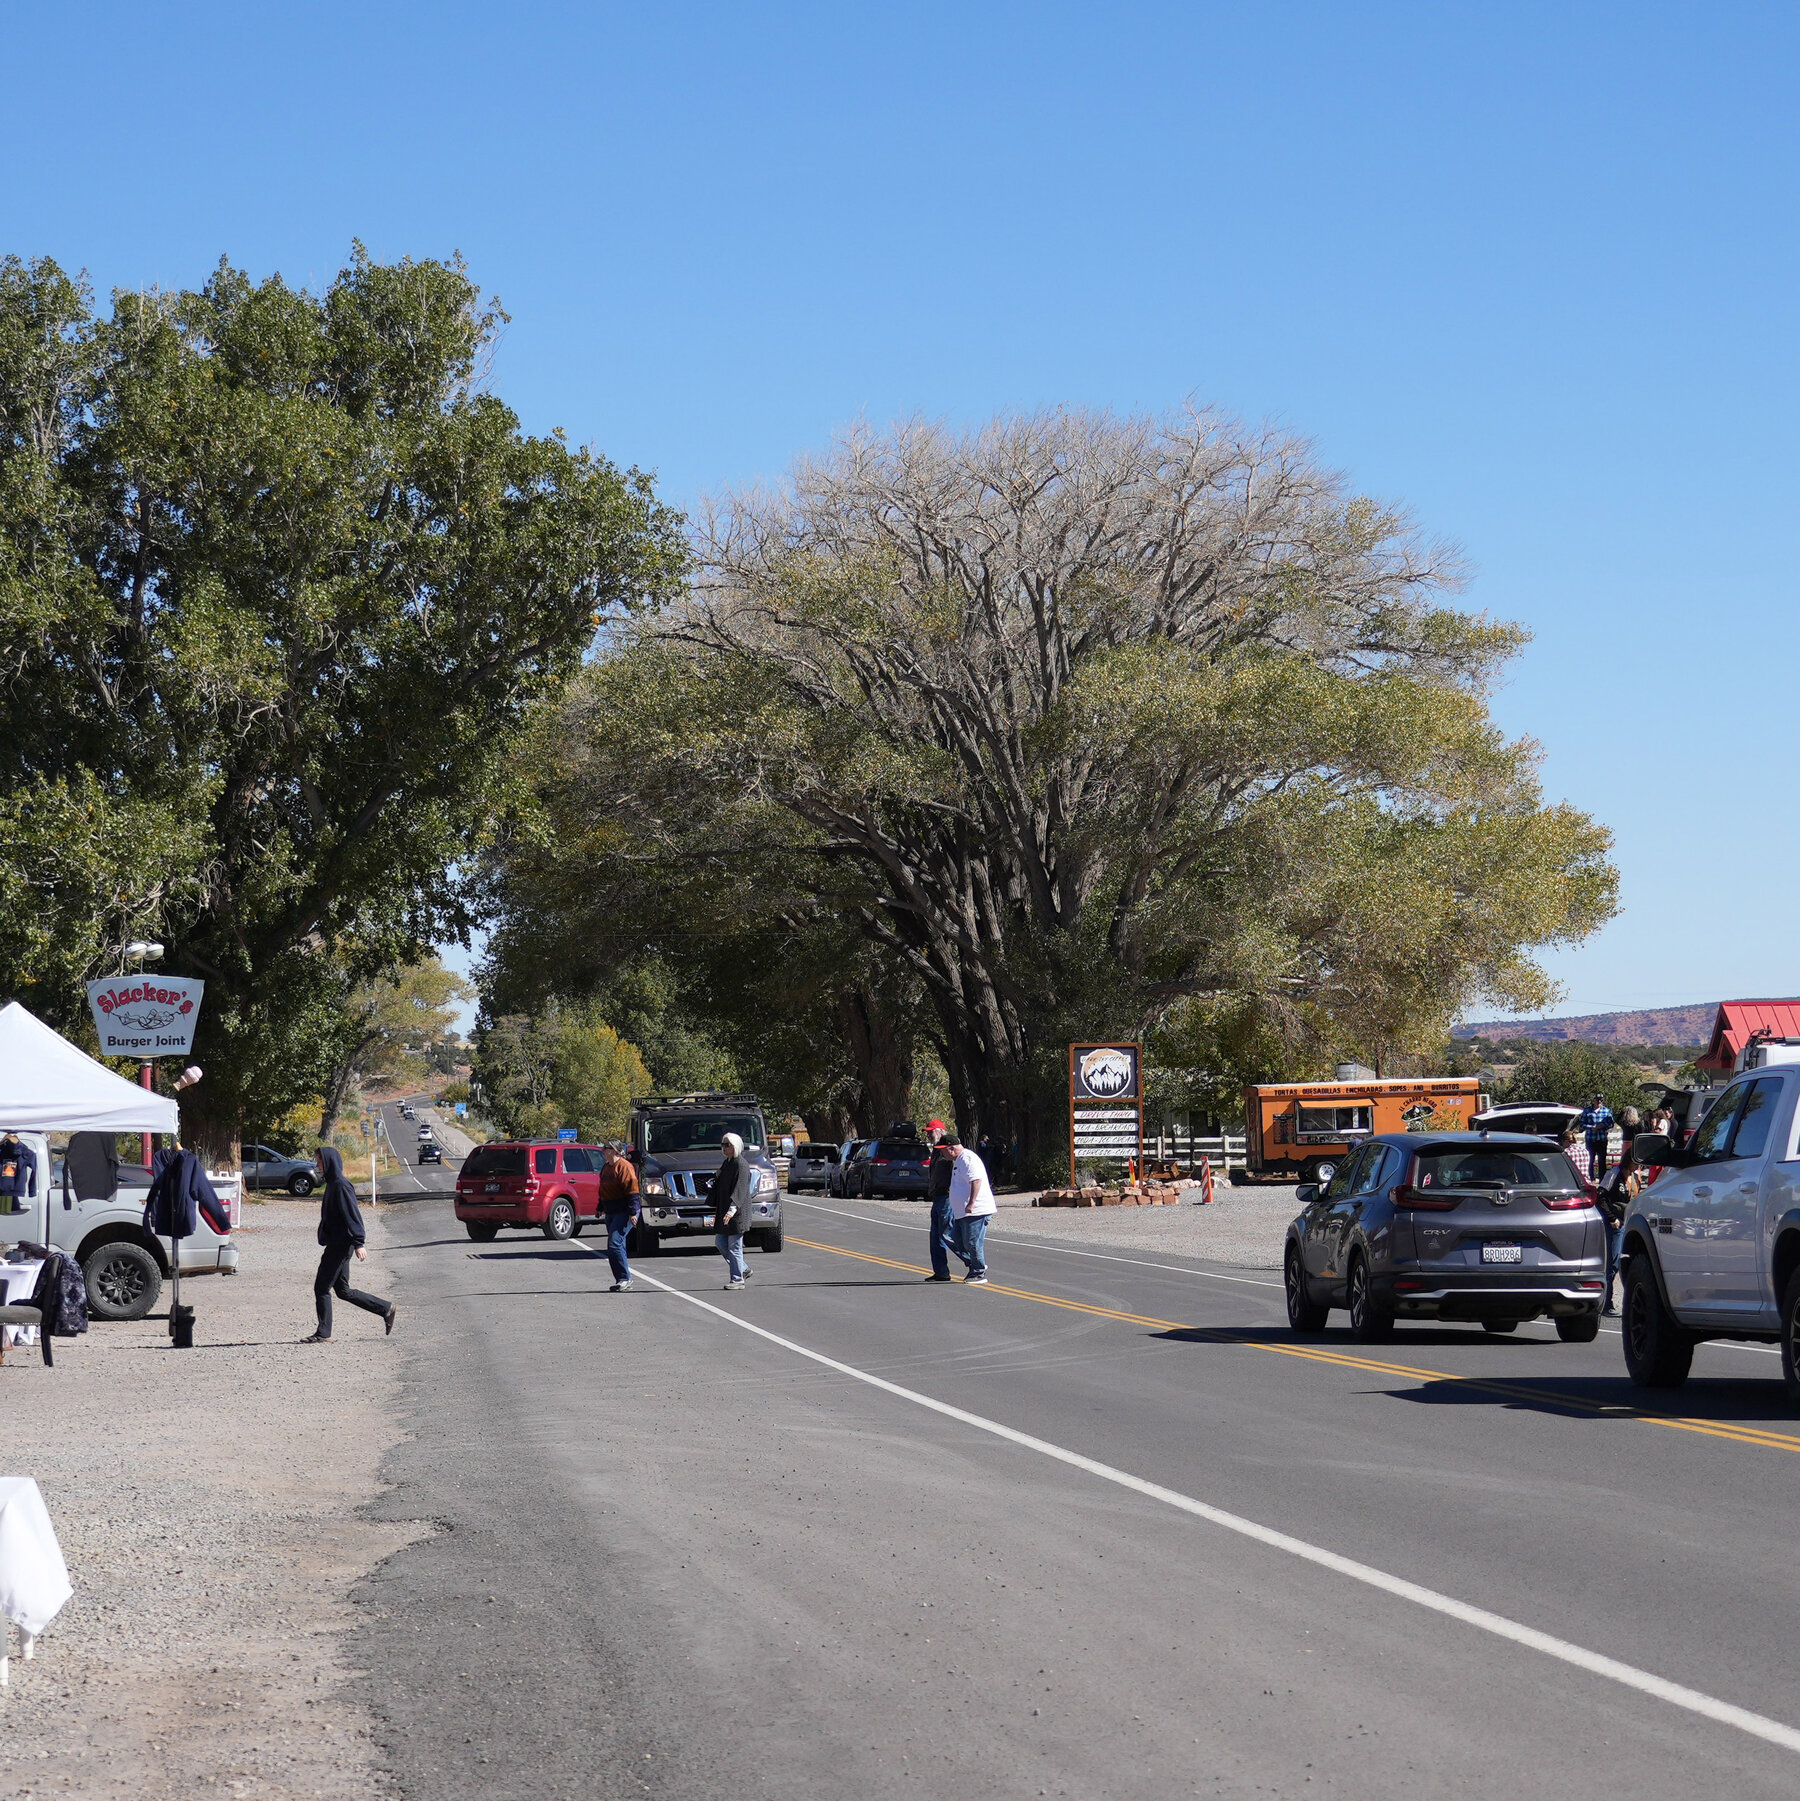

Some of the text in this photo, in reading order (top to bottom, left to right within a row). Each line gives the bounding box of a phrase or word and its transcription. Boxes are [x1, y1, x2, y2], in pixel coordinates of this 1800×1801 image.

[97, 982, 194, 1014] Slacker's
[107, 1035, 186, 1048] Burger Joint
[1431, 1083, 1460, 1091] BURRITOS
